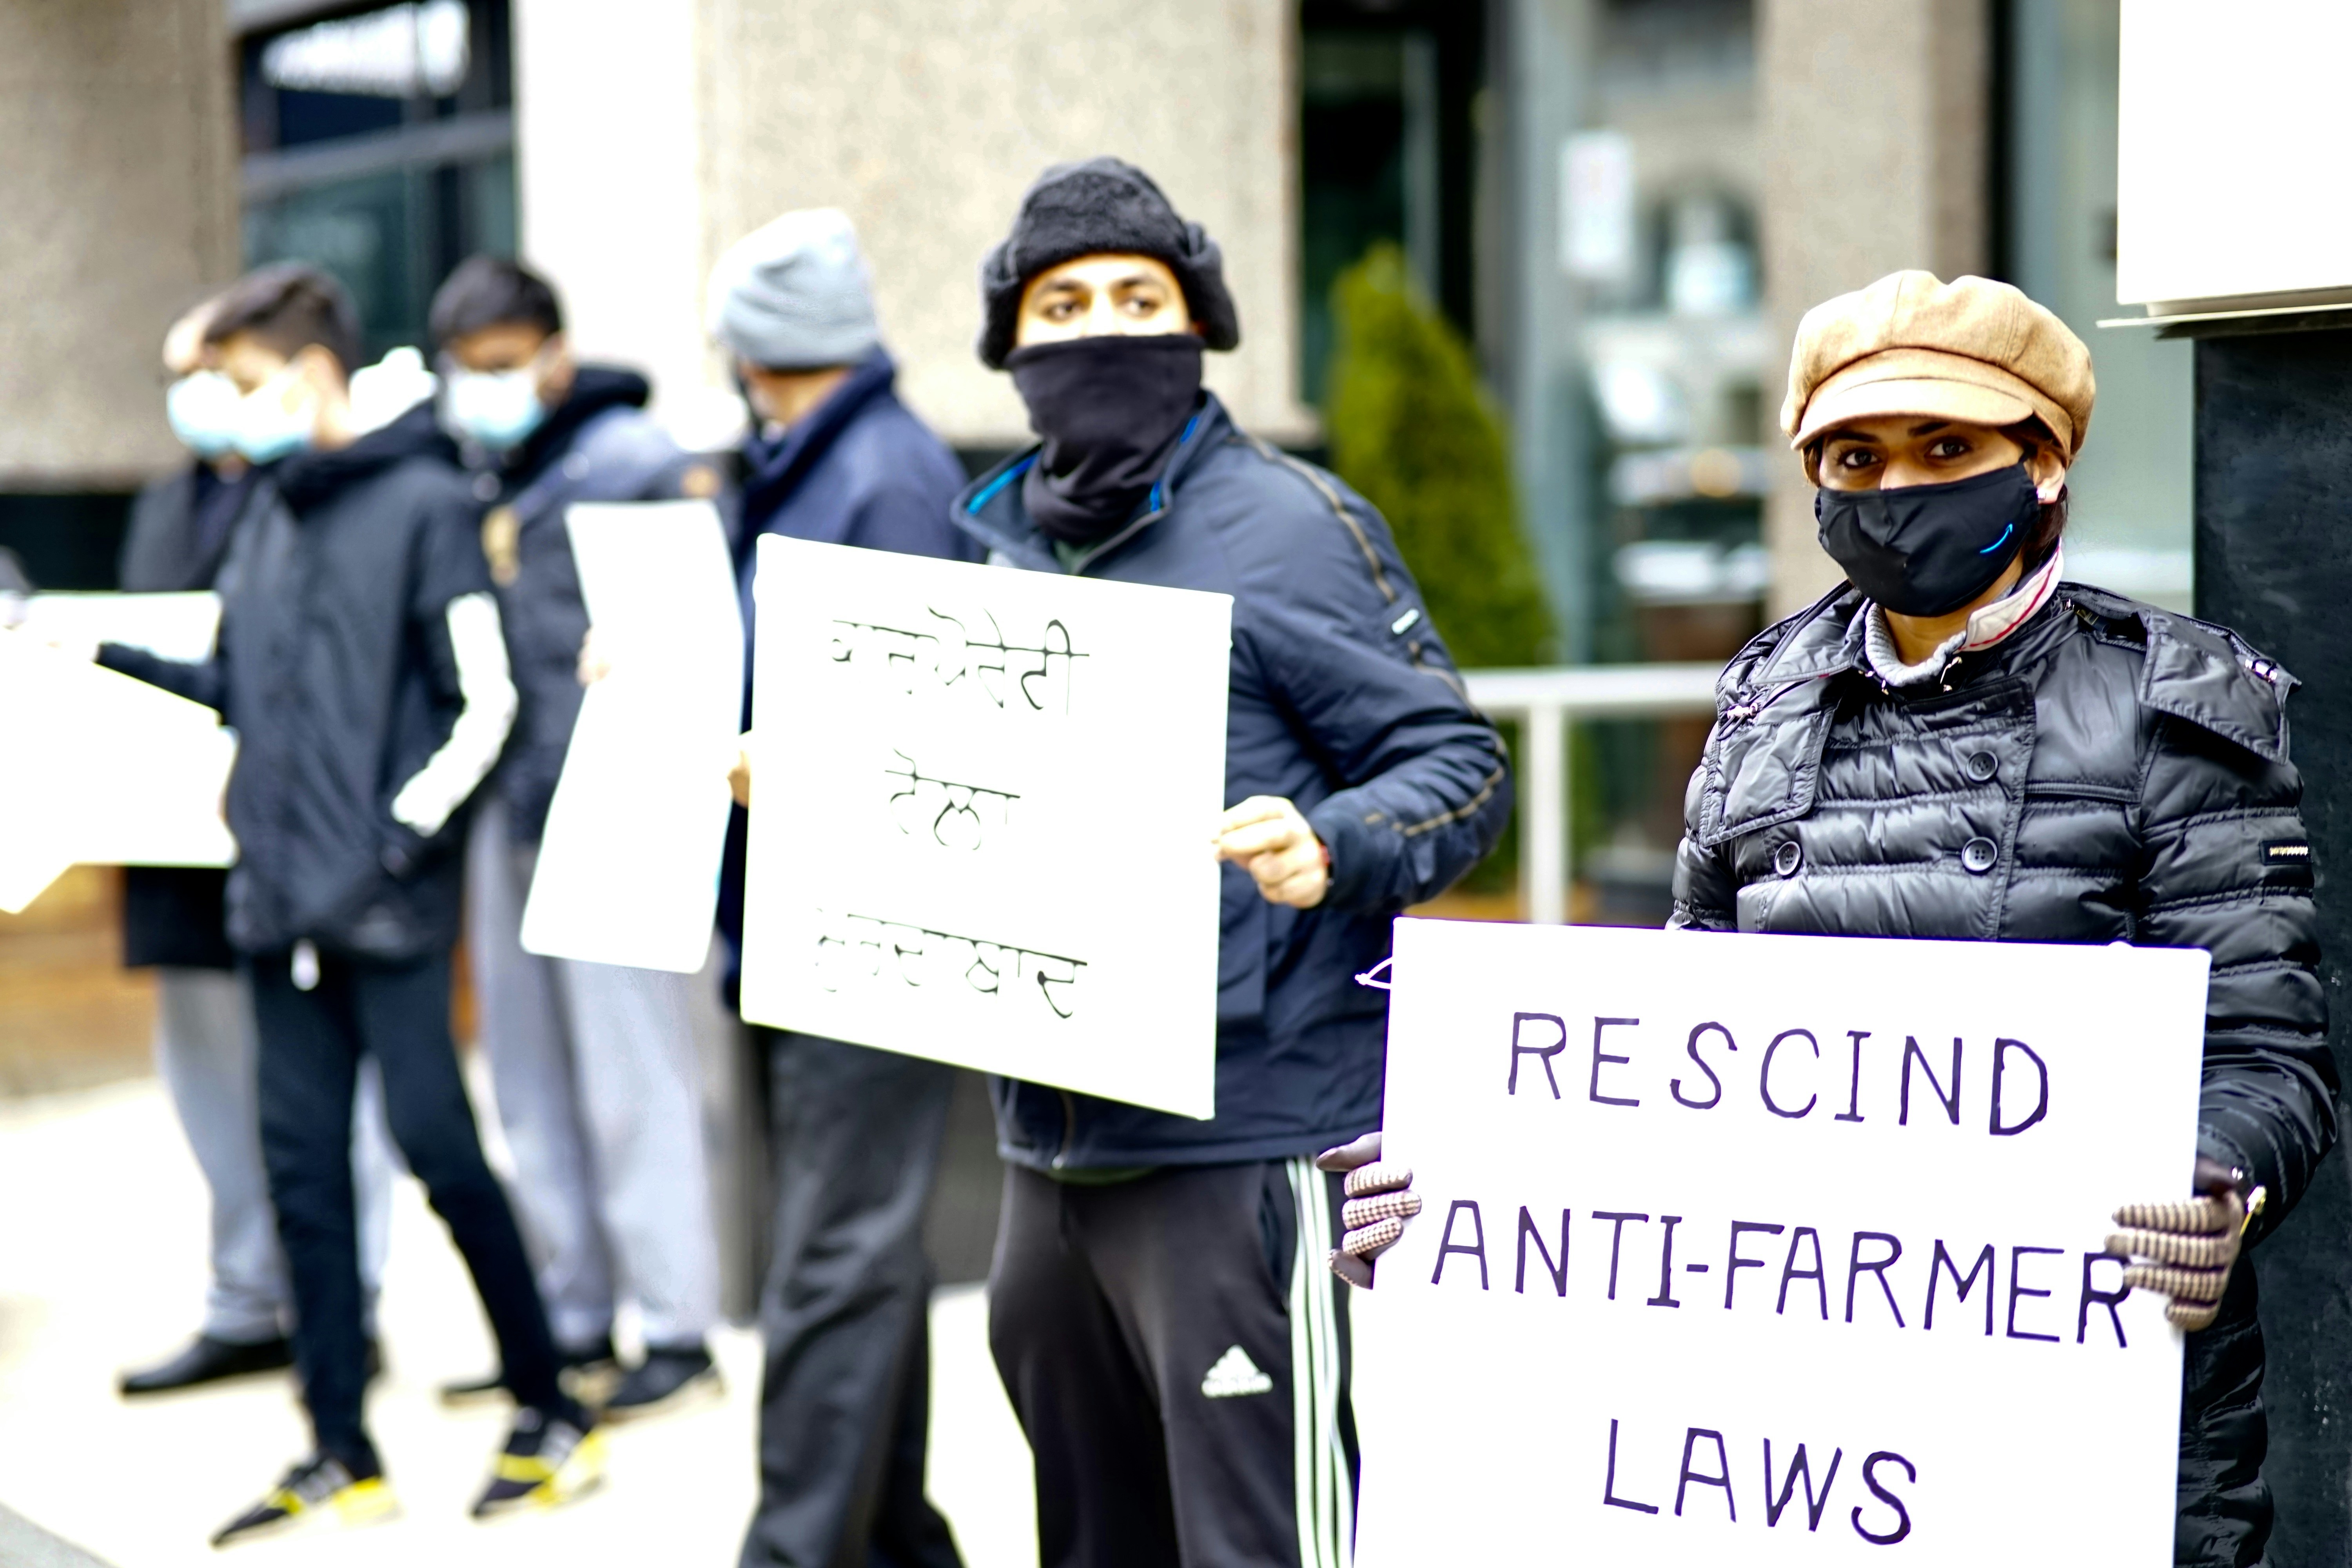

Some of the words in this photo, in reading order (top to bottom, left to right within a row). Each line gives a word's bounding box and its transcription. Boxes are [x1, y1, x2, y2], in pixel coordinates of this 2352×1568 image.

[831, 604, 1091, 717] ਕਰਪੋਰੇਟੀ
[1507, 1011, 2049, 1136] RESCIND
[1430, 1199, 2132, 1348] ANTI-FARMER
[1603, 1418, 1917, 1546] LAWS
